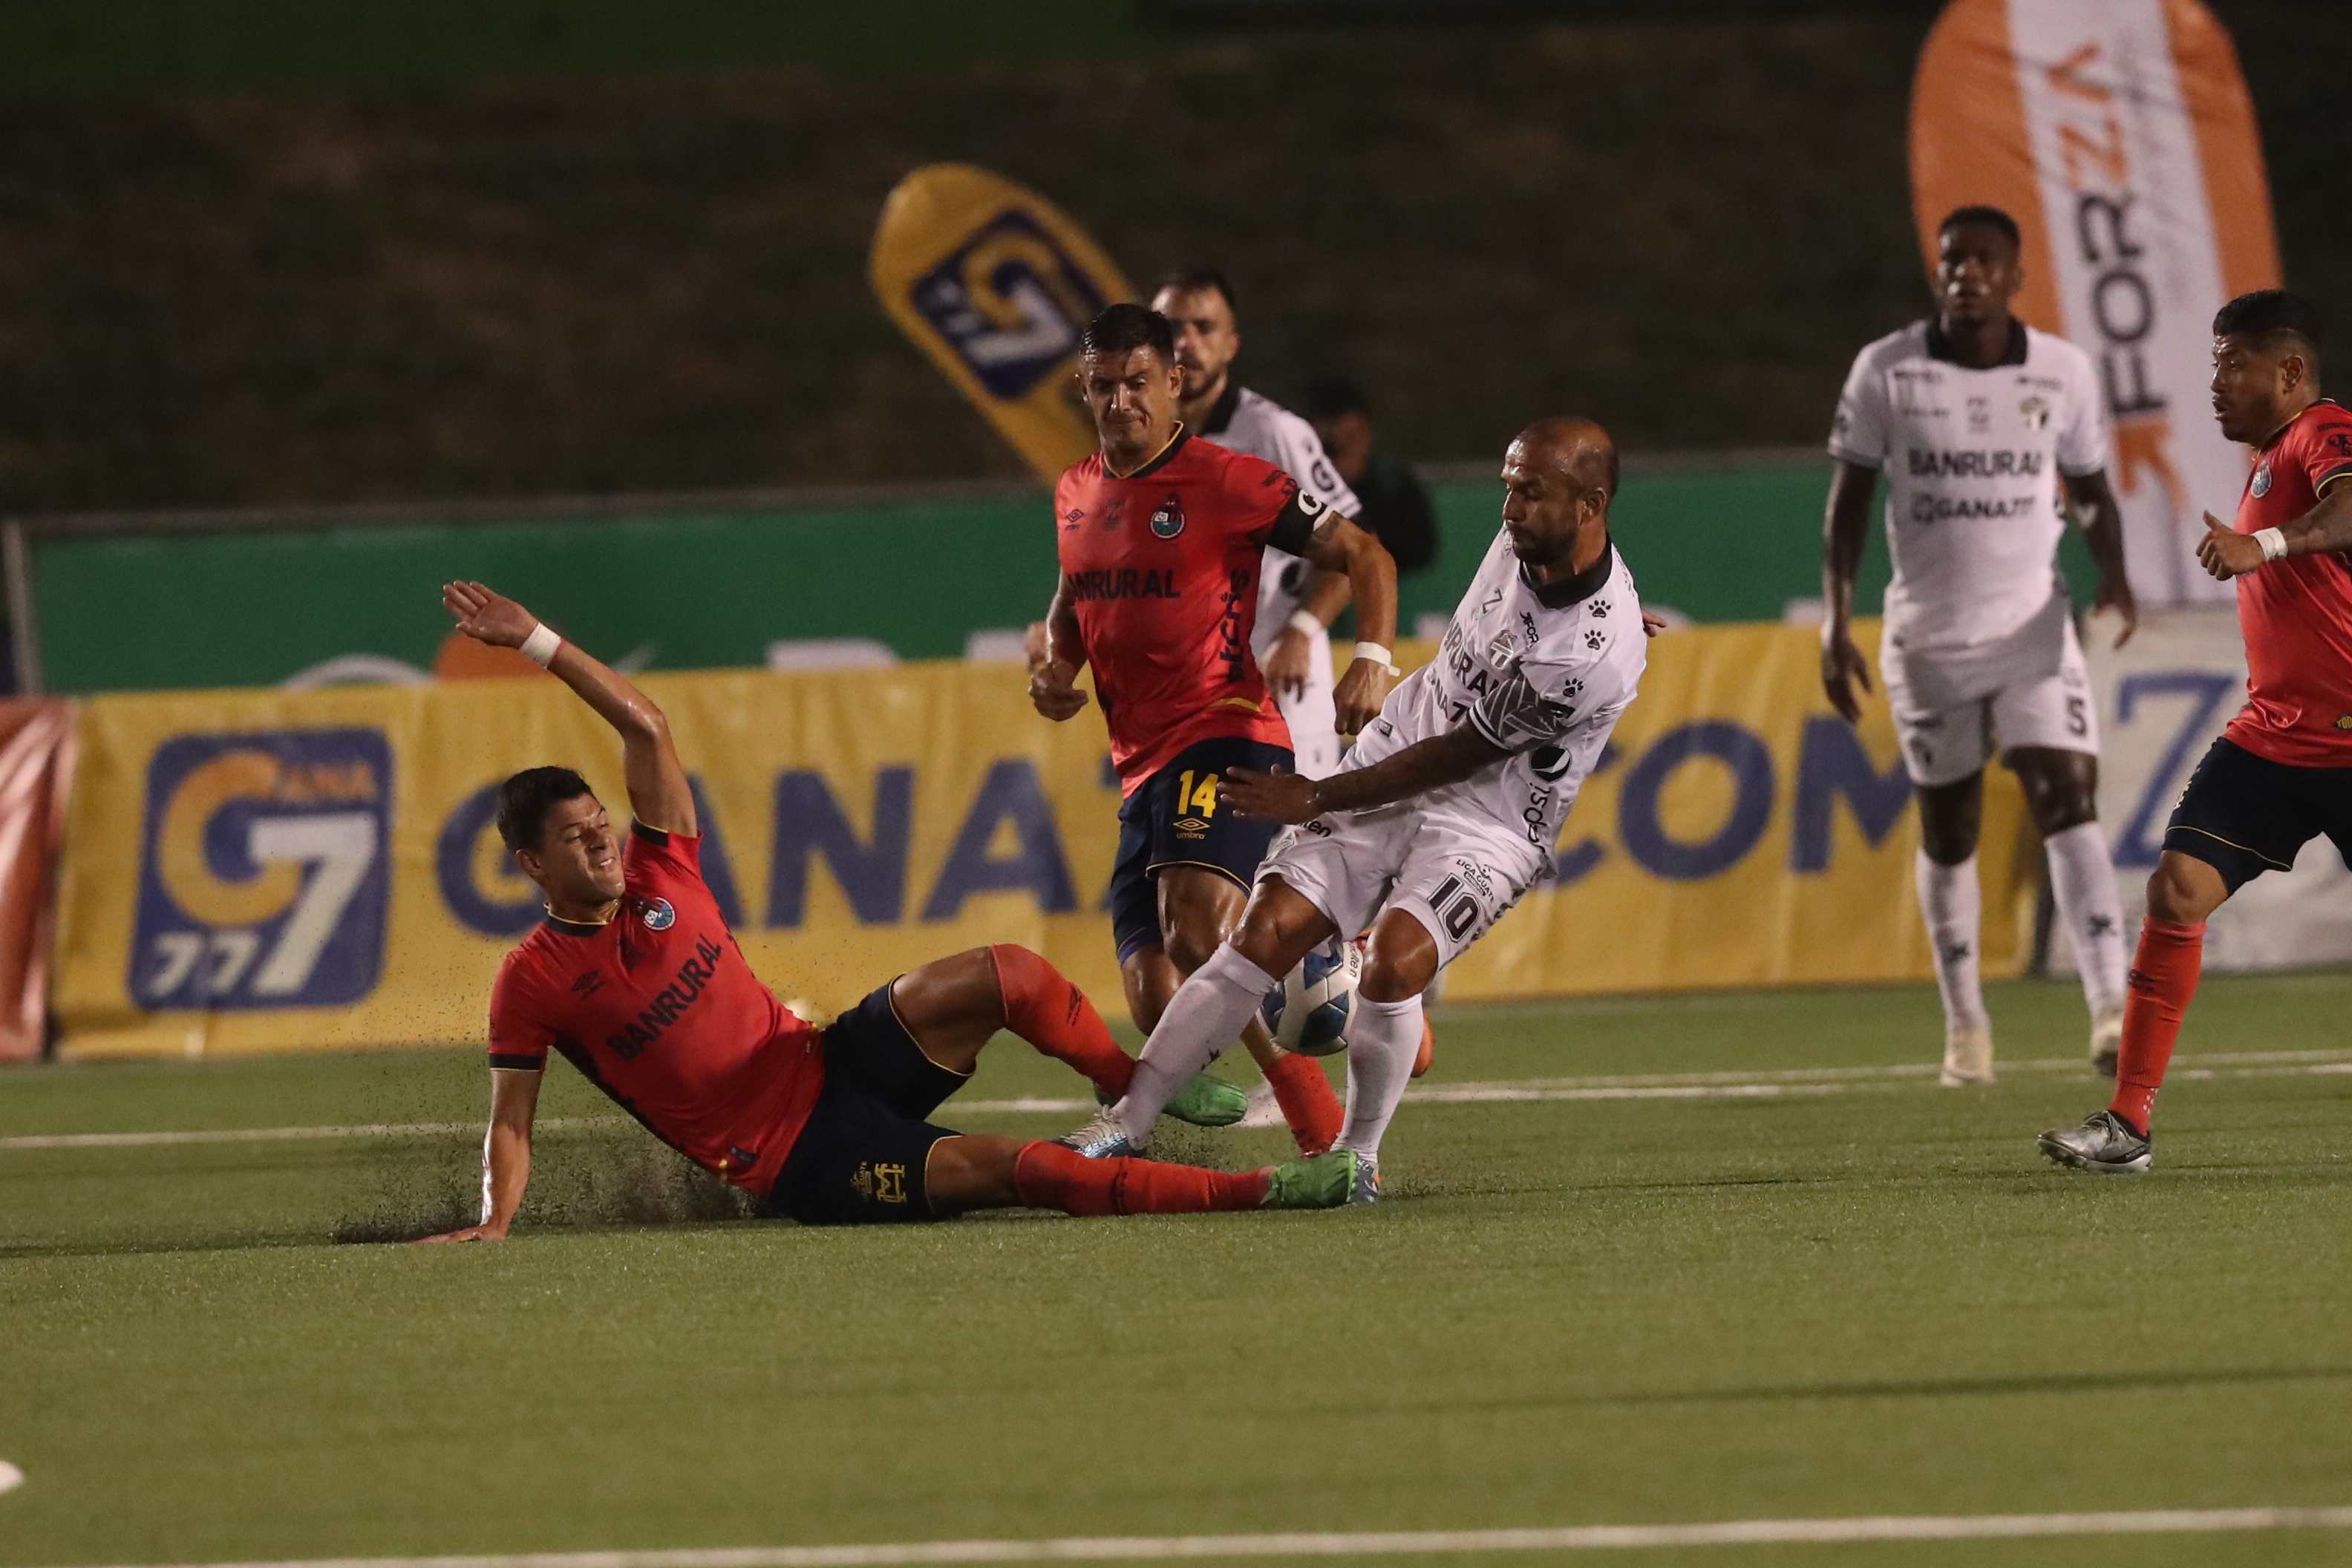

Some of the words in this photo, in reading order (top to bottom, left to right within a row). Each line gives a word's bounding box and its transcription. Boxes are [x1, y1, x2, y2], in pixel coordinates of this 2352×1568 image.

[1908, 448, 2040, 477] BANRURAL
[1177, 769, 1218, 818] 14
[1176, 832, 1205, 840] umbro
[1427, 872, 1482, 944] 10
[607, 932, 722, 1060] BANRURAL
